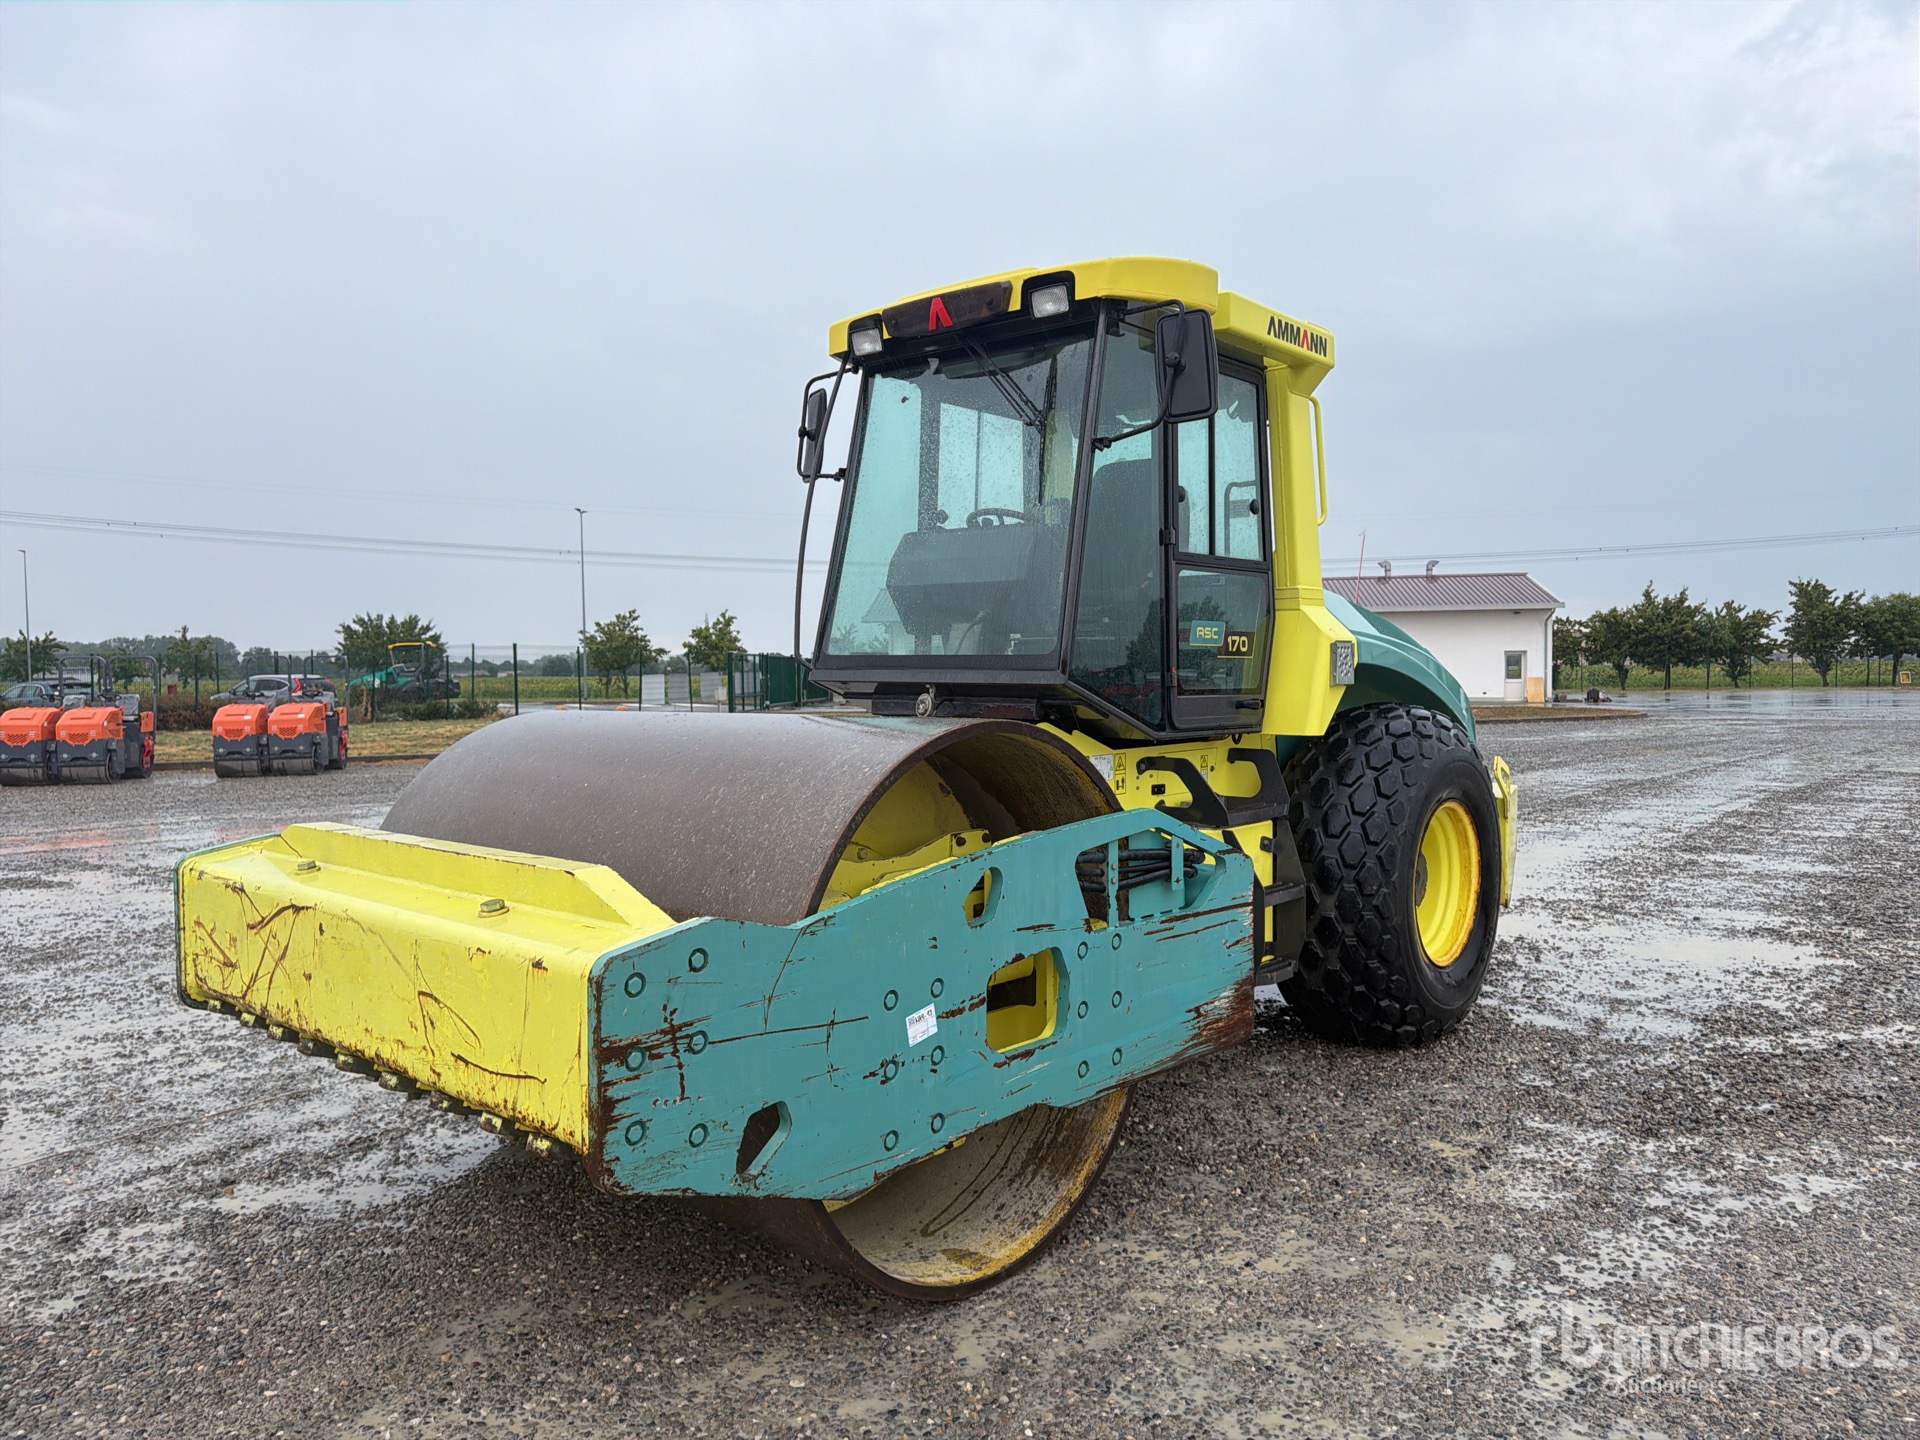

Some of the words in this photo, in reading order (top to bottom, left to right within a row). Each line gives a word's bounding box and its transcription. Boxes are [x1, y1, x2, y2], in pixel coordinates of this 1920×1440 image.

[1267, 315, 1327, 357] AMMANN
[1196, 626, 1219, 639] ASC
[1228, 635, 1248, 652] 170
